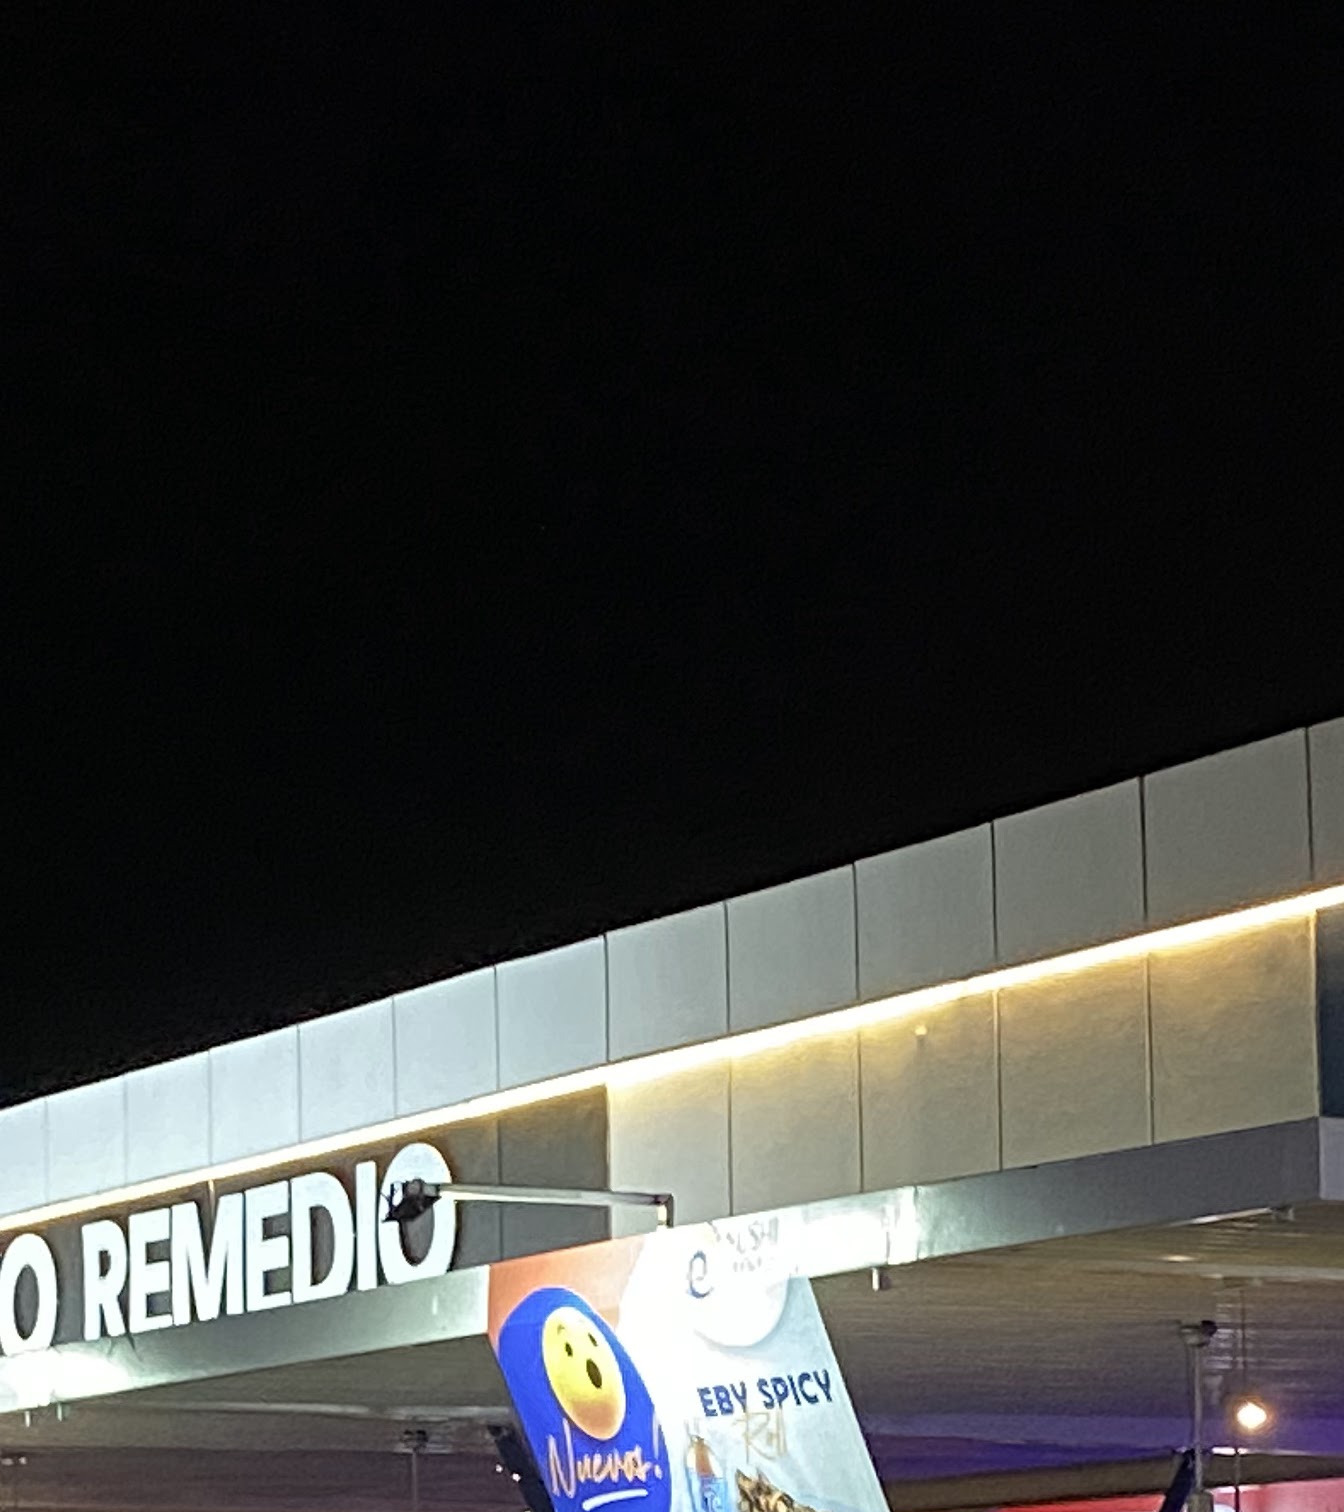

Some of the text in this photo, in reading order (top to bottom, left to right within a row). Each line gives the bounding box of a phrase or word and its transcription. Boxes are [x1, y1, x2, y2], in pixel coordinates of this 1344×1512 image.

[81, 1142, 457, 1342] REMEDIO
[697, 1369, 833, 1417] EBY SPICY
